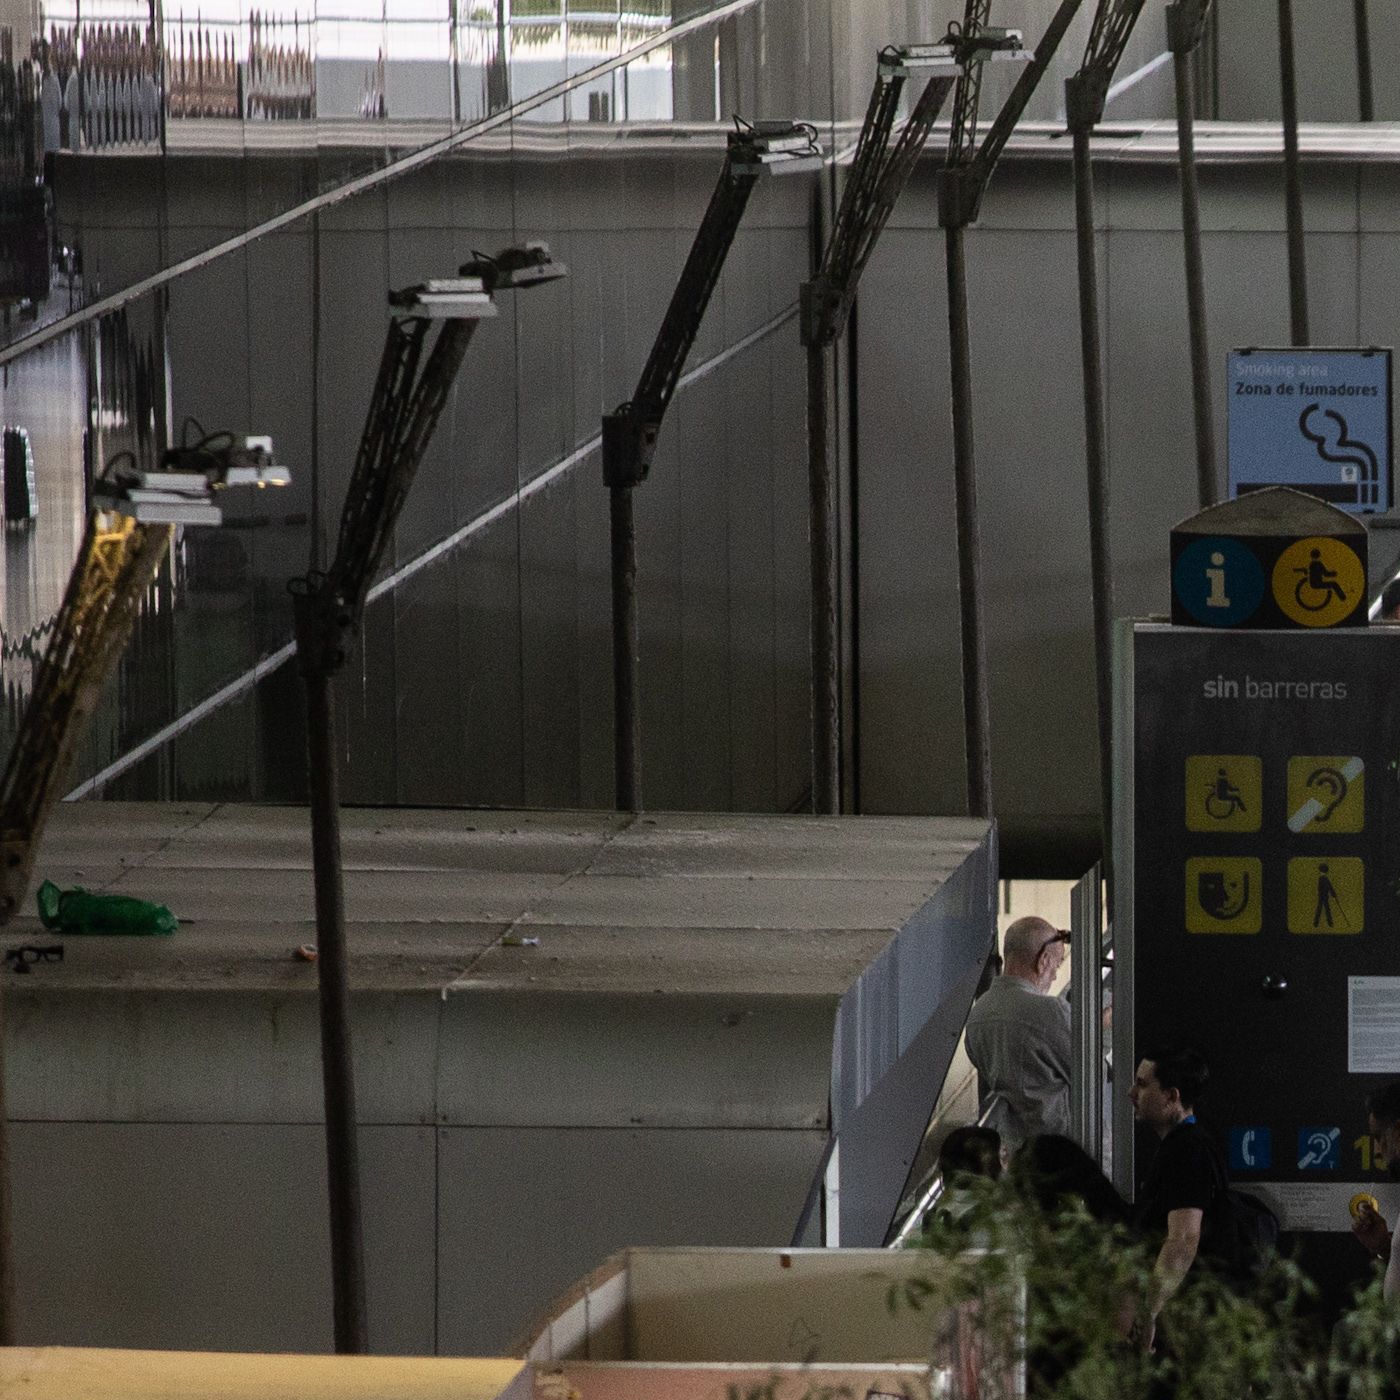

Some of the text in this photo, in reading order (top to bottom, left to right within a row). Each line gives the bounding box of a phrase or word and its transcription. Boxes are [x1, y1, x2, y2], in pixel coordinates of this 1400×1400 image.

[1235, 361, 1295, 379] Smoking
[1235, 382, 1378, 397] Zona de fumadores
[1203, 675, 1347, 699] sin barreras
